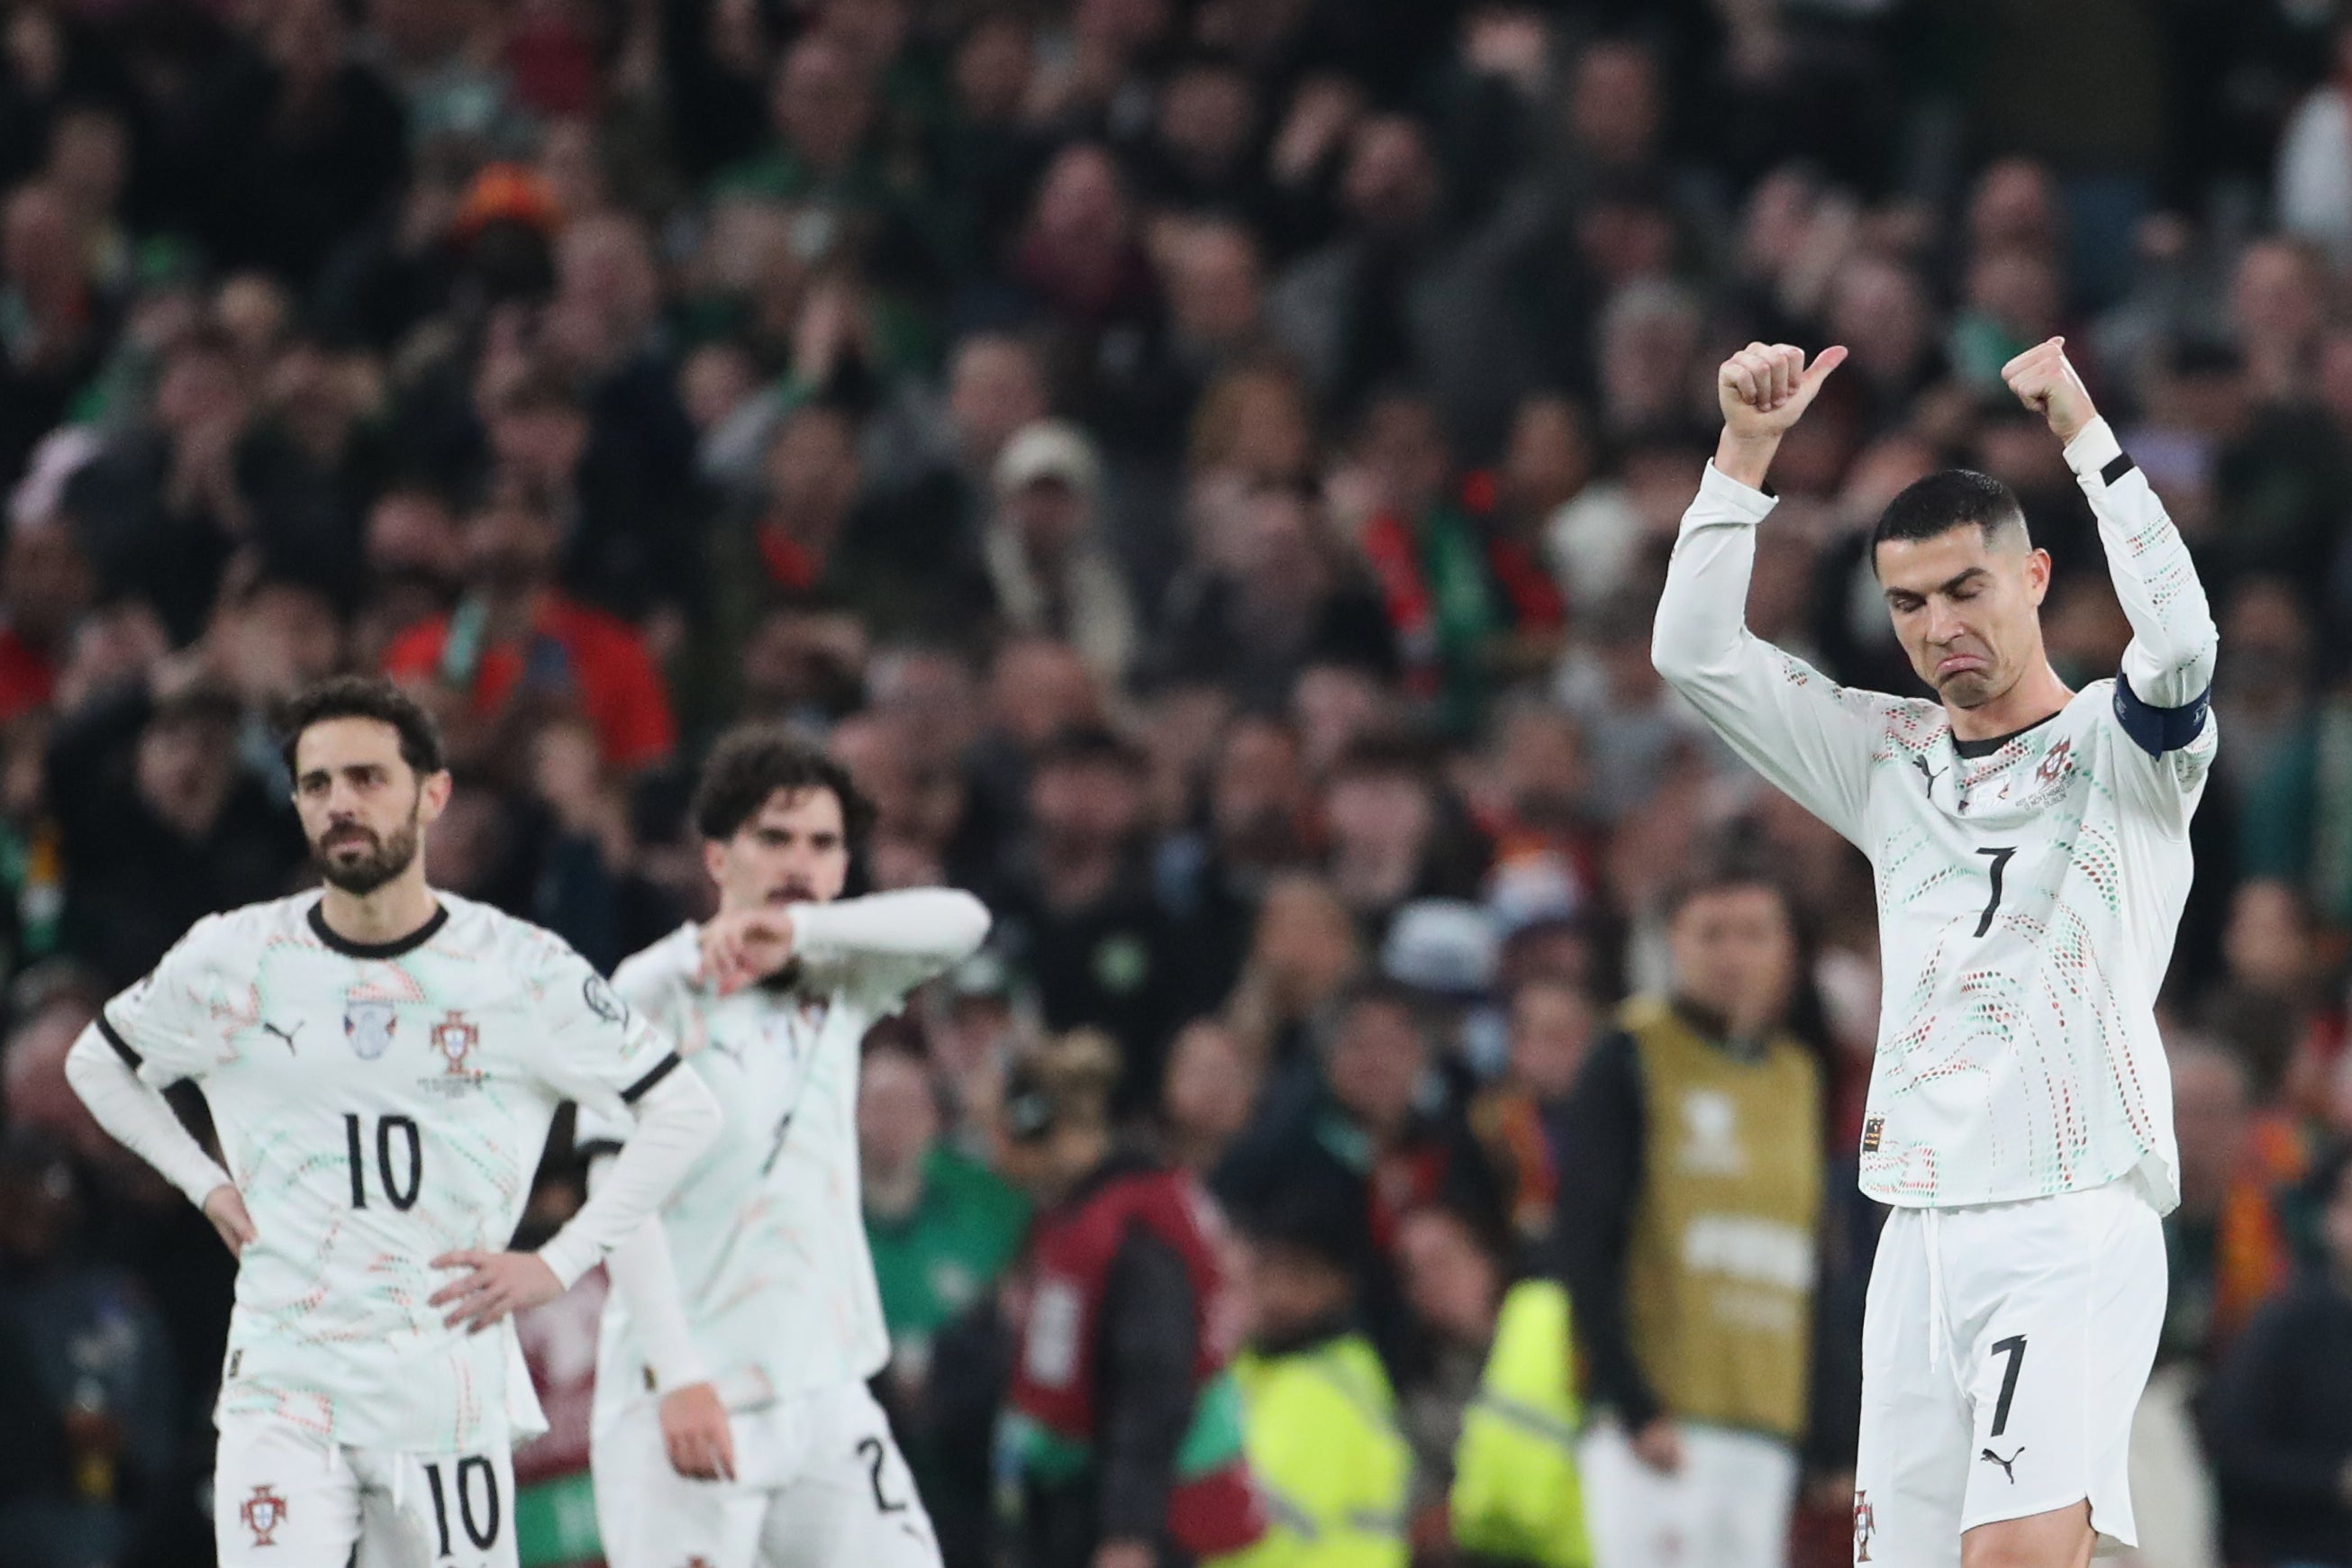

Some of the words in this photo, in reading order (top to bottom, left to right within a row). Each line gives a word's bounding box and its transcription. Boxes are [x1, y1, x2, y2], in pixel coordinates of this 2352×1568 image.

[1973, 846, 2018, 938] 7
[342, 1113, 422, 1212] 10
[1990, 1333, 2028, 1437] 7
[422, 1455, 500, 1558] 10
[856, 1437, 907, 1512] 2
